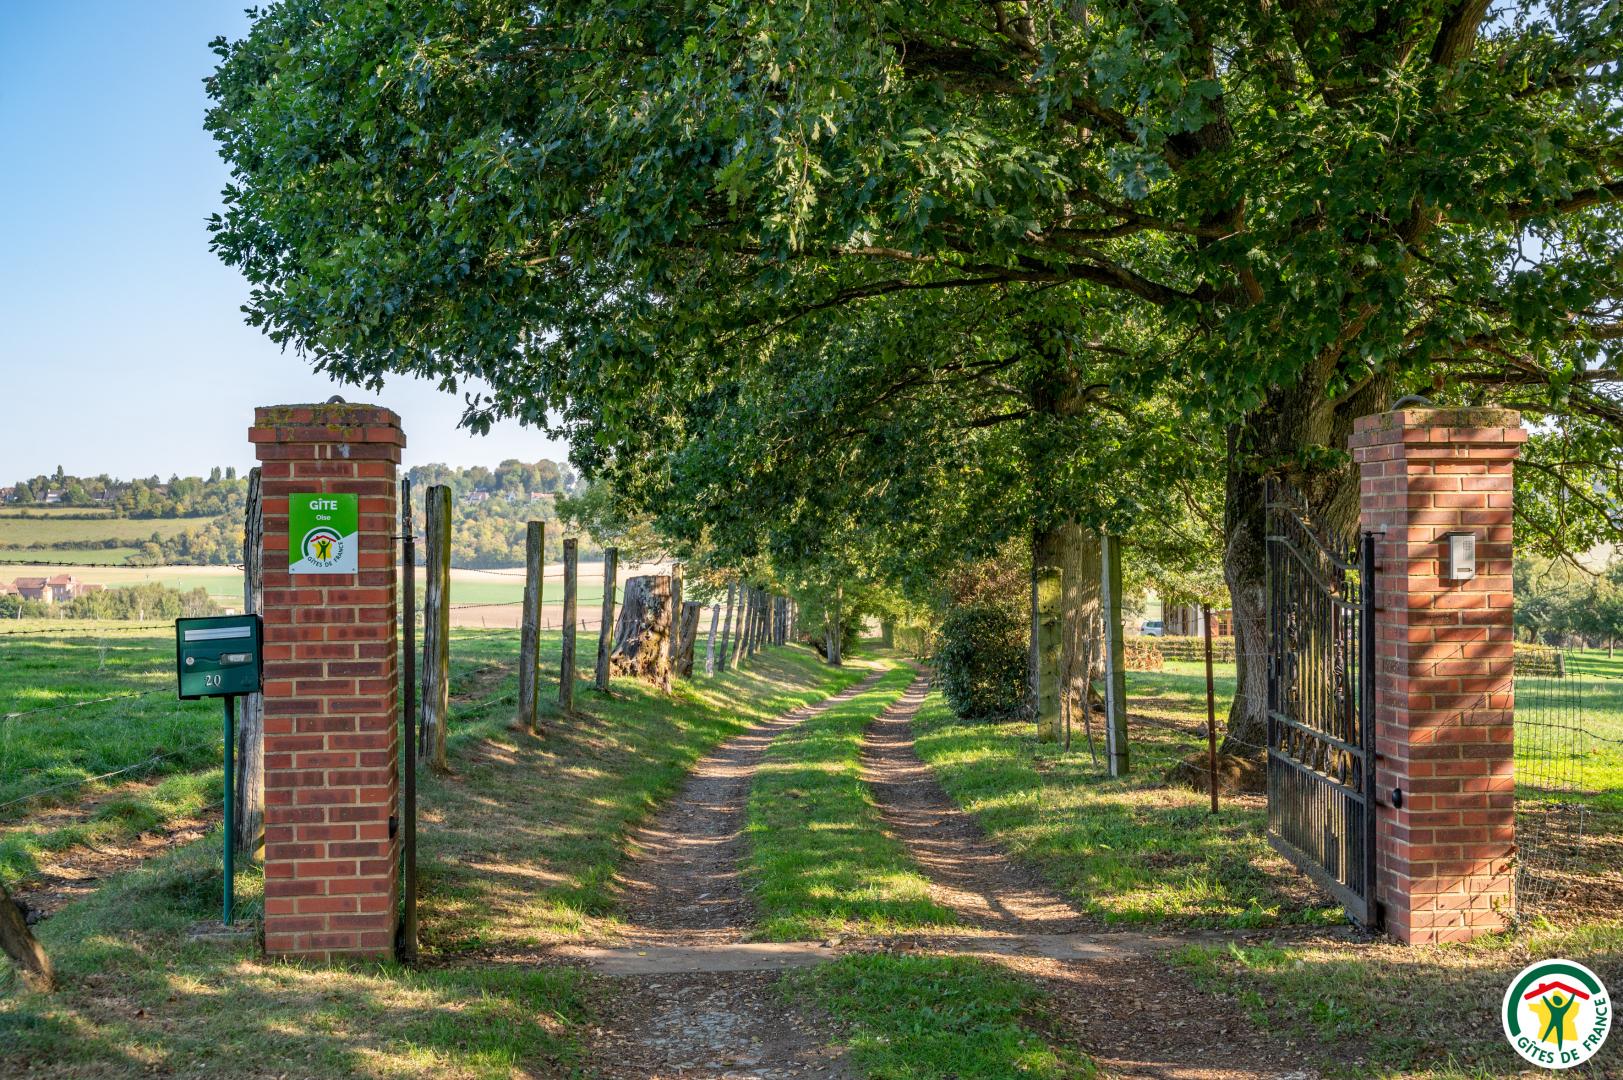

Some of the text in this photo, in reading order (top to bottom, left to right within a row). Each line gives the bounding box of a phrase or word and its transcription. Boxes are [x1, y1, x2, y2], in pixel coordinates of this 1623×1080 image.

[309, 498, 338, 511] GÎTE
[333, 542, 344, 563] FRANCE
[205, 674, 221, 687] 20
